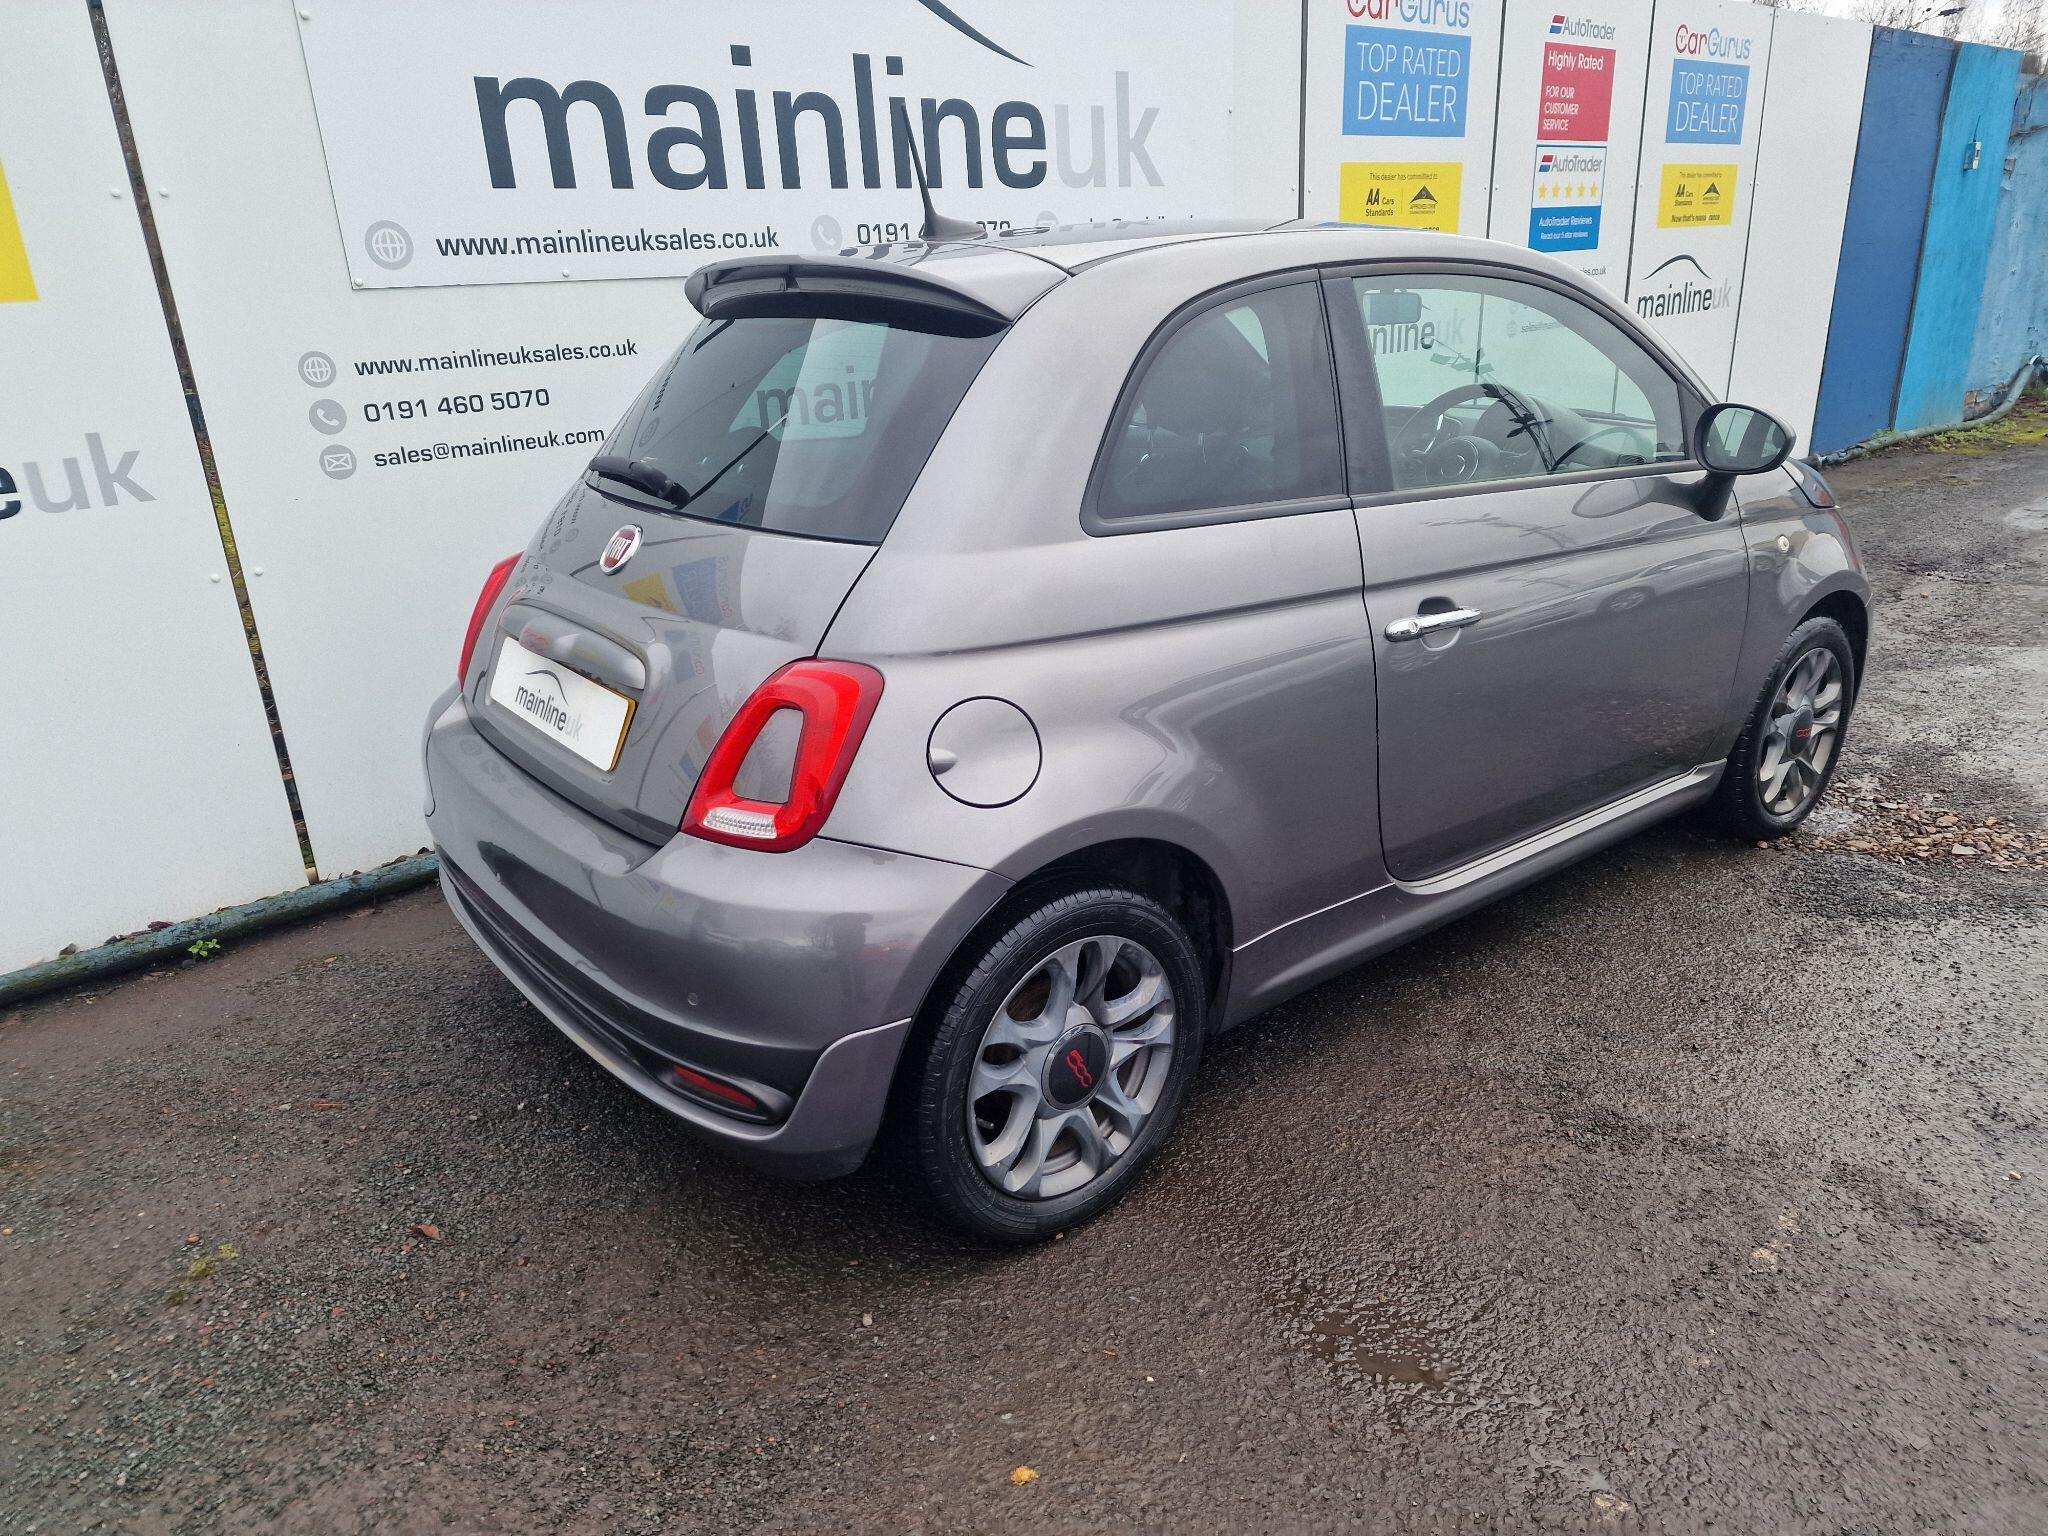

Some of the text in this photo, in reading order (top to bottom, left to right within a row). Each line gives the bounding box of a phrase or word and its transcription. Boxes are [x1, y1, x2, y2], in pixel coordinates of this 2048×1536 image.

[1562, 17, 1616, 40] AutoTrader
[1675, 24, 1751, 59] CarGurus
[1357, 42, 1461, 77] TOP RATED
[1548, 50, 1604, 70] Highly Rated
[1545, 86, 1575, 99] FOR OUR
[1679, 72, 1743, 98] TOP RATED
[1358, 81, 1457, 123] DEALER
[1544, 102, 1579, 114] CUSTOMER
[1543, 118, 1569, 131] SERVICE
[1675, 101, 1739, 133] DEALER
[1551, 155, 1603, 172] AutoTrader
[1366, 188, 1394, 205] AA Cars
[1365, 208, 1394, 217] Standards
[435, 226, 779, 257] www.mainlineuksales.co.uk
[857, 223, 909, 244] 0191
[1581, 265, 1606, 276] les.co.uk
[1637, 278, 1732, 319] mainlineuk
[354, 339, 639, 376] www.mainlineuksales.co.uk
[364, 388, 551, 423] 0191 460 5070
[374, 426, 606, 467] sales@mainlineuk.com
[515, 685, 583, 741] mainlineuk
